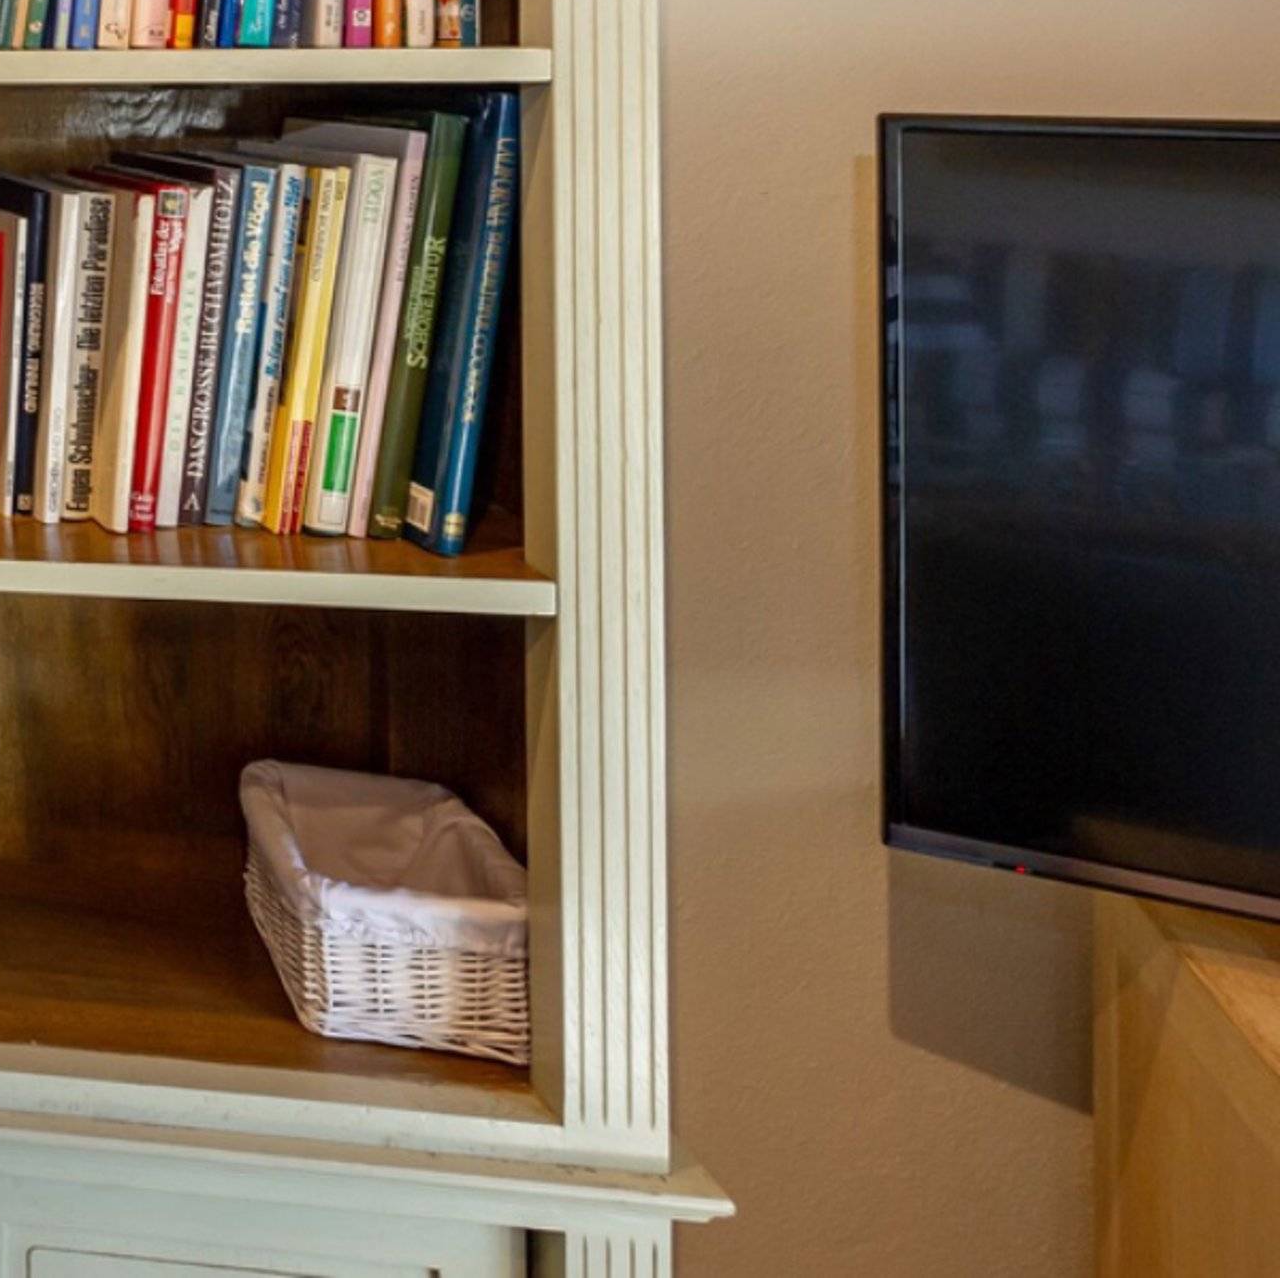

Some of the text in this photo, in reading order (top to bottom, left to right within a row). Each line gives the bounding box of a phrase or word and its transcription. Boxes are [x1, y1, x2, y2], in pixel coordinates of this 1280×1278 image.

[82, 197, 111, 271] Paradiese
[244, 181, 269, 238] Vögel
[77, 275, 106, 323] letzten
[186, 176, 235, 479] DAS GROSSE BUCH VOM HOLZ
[75, 326, 101, 351] Die
[67, 364, 100, 464] Schuhmacher
[65, 468, 92, 513] Eugen
